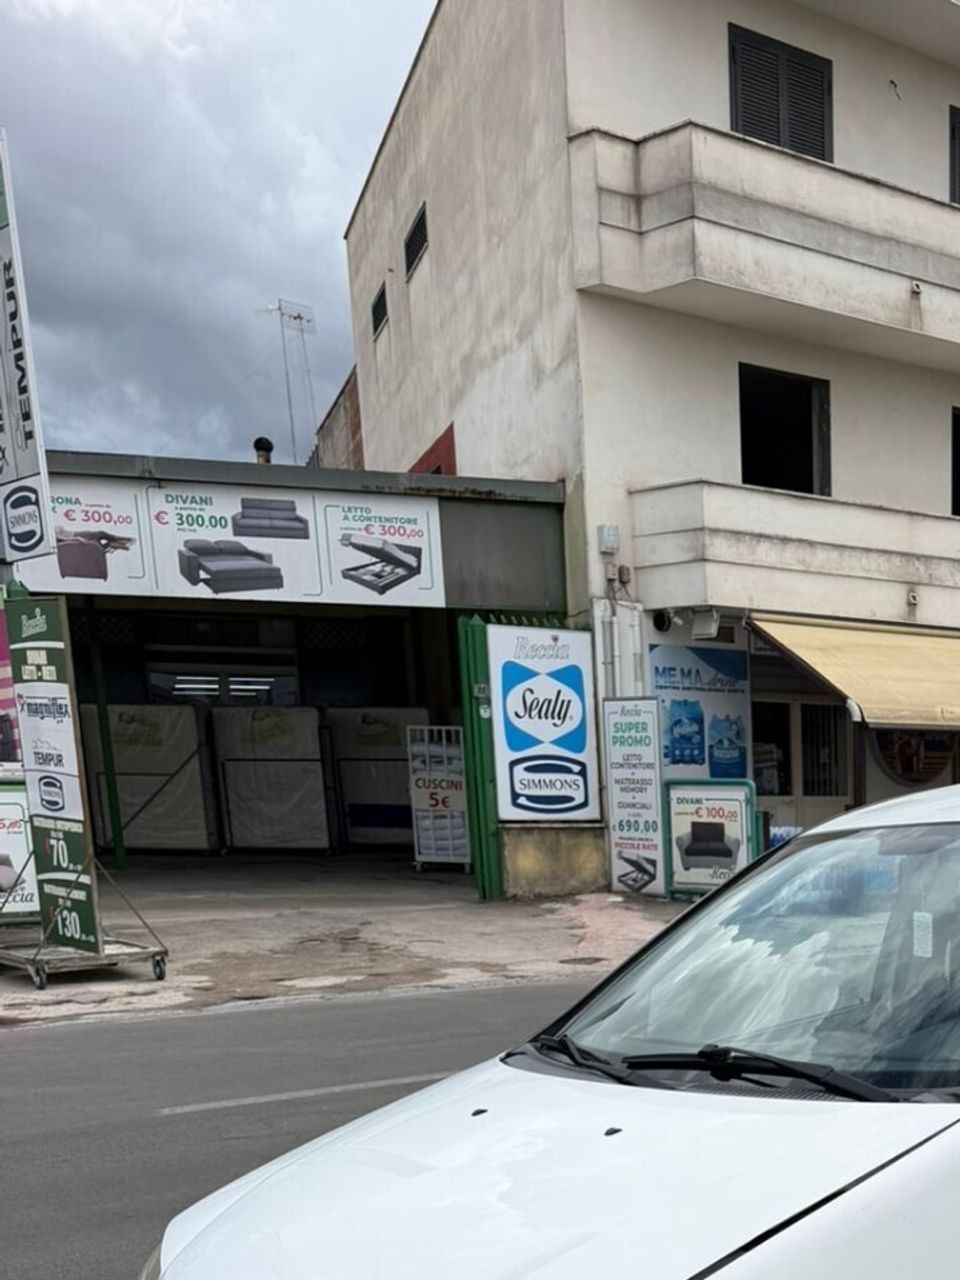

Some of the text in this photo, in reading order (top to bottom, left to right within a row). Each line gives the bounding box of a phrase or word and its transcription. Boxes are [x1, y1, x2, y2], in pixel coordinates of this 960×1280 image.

[3, 257, 34, 449] TEMPUR
[165, 494, 213, 506] DIVANI
[64, 509, 76, 521] €
[81, 510, 133, 525] 300,00
[341, 506, 372, 514] LETTO
[154, 511, 169, 525] €
[352, 515, 418, 525] CONTENITORE
[364, 524, 424, 538] € 300,00
[514, 687, 572, 727] Sealy
[613, 721, 649, 733] SUPER
[612, 735, 652, 747] PROMO
[33, 751, 65, 768] TEMPUR
[415, 777, 463, 791] CUSCINI
[519, 777, 581, 791] SIMMONS
[695, 807, 704, 818] €
[50, 838, 69, 868] 70
